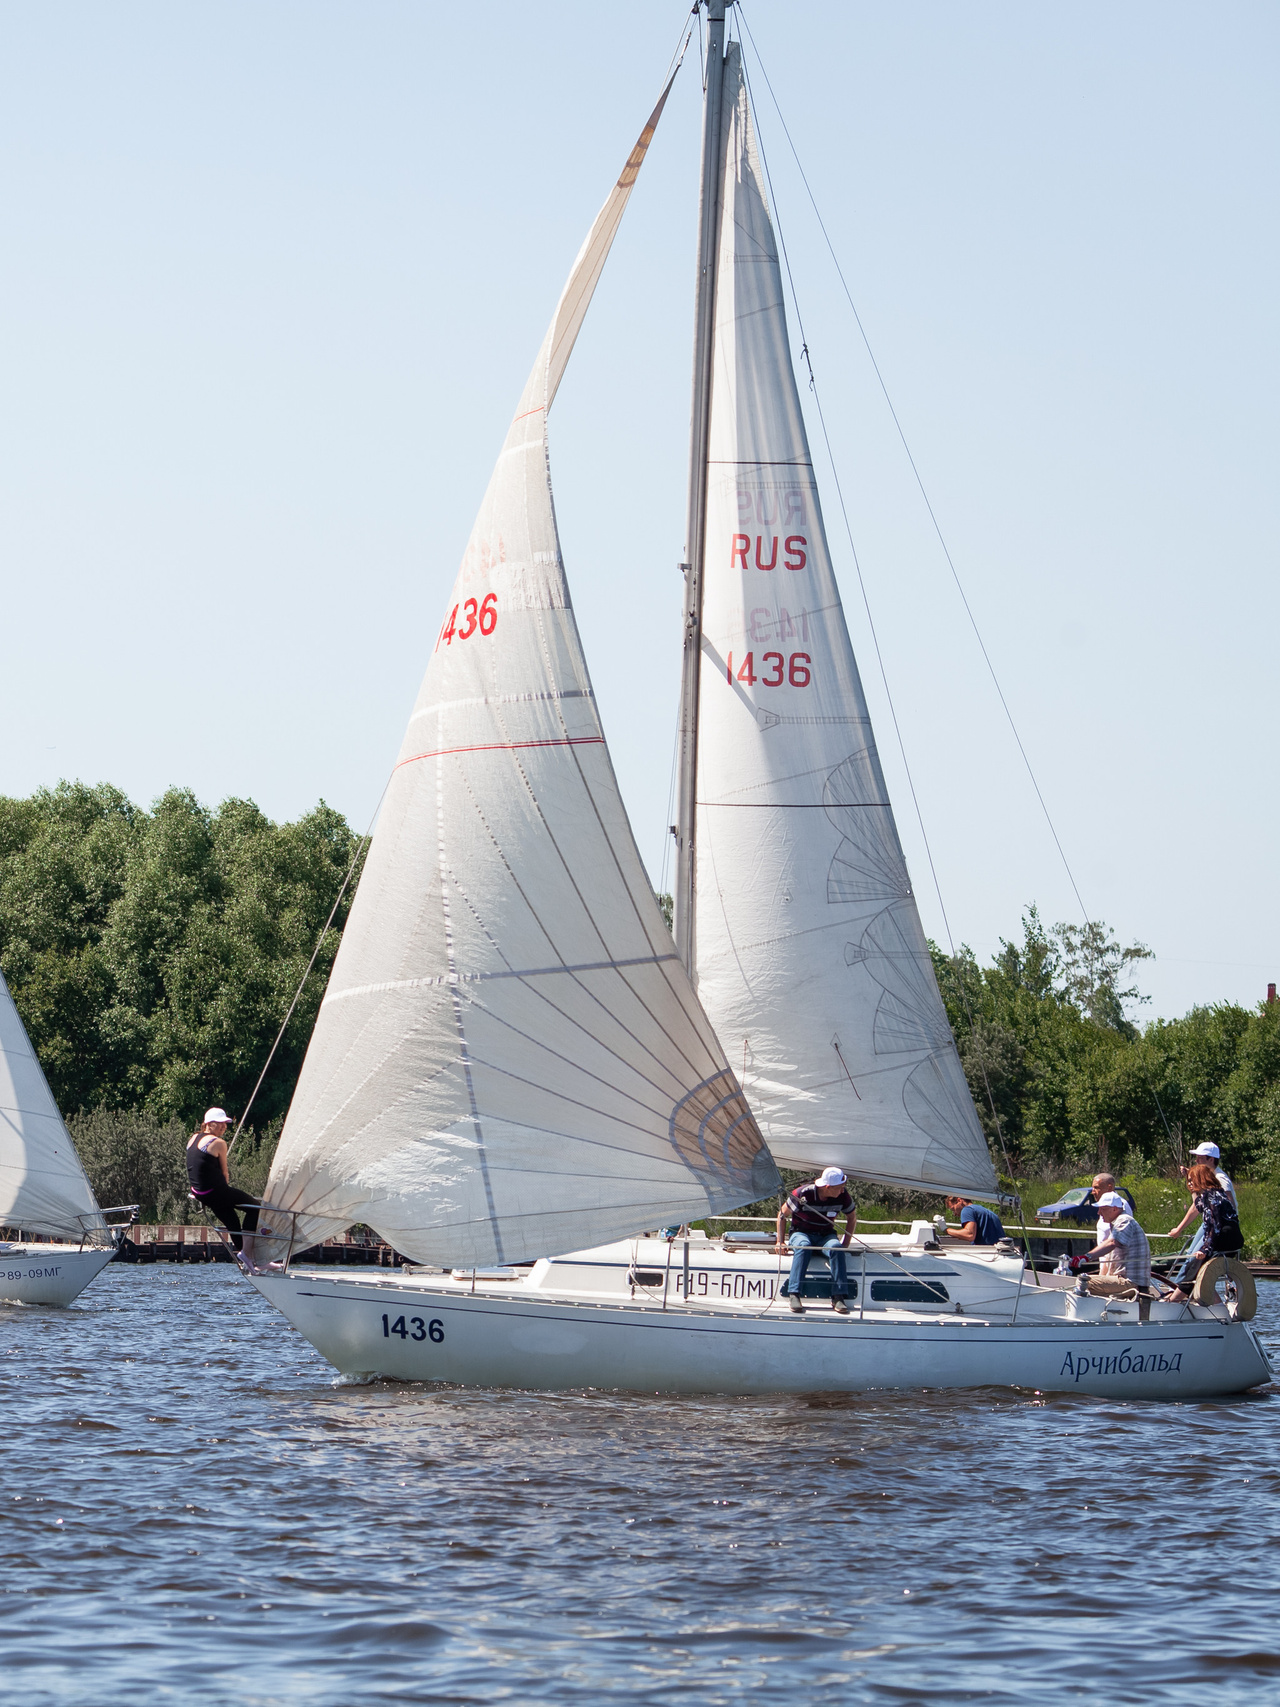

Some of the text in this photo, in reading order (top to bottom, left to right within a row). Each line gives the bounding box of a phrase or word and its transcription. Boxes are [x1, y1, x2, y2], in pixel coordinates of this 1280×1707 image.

[730, 533, 808, 571] RUS
[726, 650, 812, 688] 1436
[381, 1313, 445, 1343] 1436
[1059, 1347, 1183, 1382] Арчибальд
